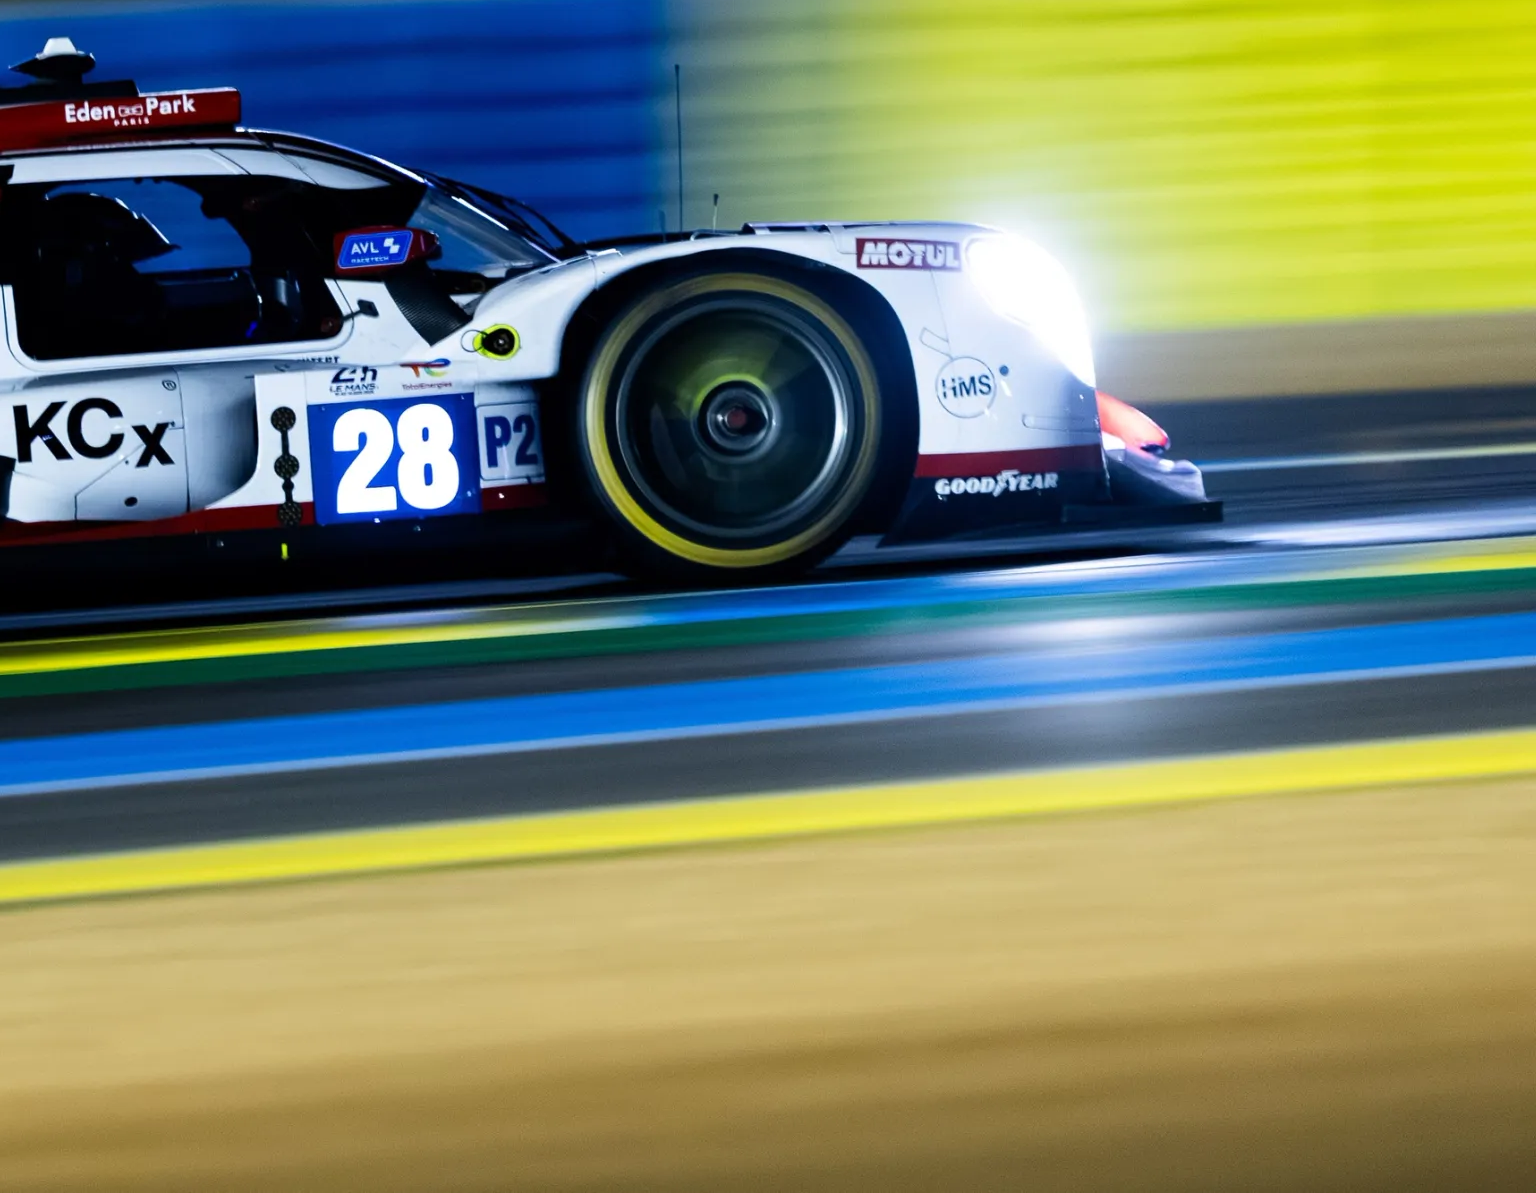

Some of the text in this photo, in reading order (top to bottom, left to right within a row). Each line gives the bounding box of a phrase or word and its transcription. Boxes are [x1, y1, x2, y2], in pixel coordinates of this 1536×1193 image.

[65, 94, 196, 123] Eden Park
[114, 117, 150, 127] PARIS
[351, 242, 379, 255] AVL
[860, 241, 960, 268] MOTUL
[484, 413, 540, 468] P2
[333, 404, 460, 514] 28
